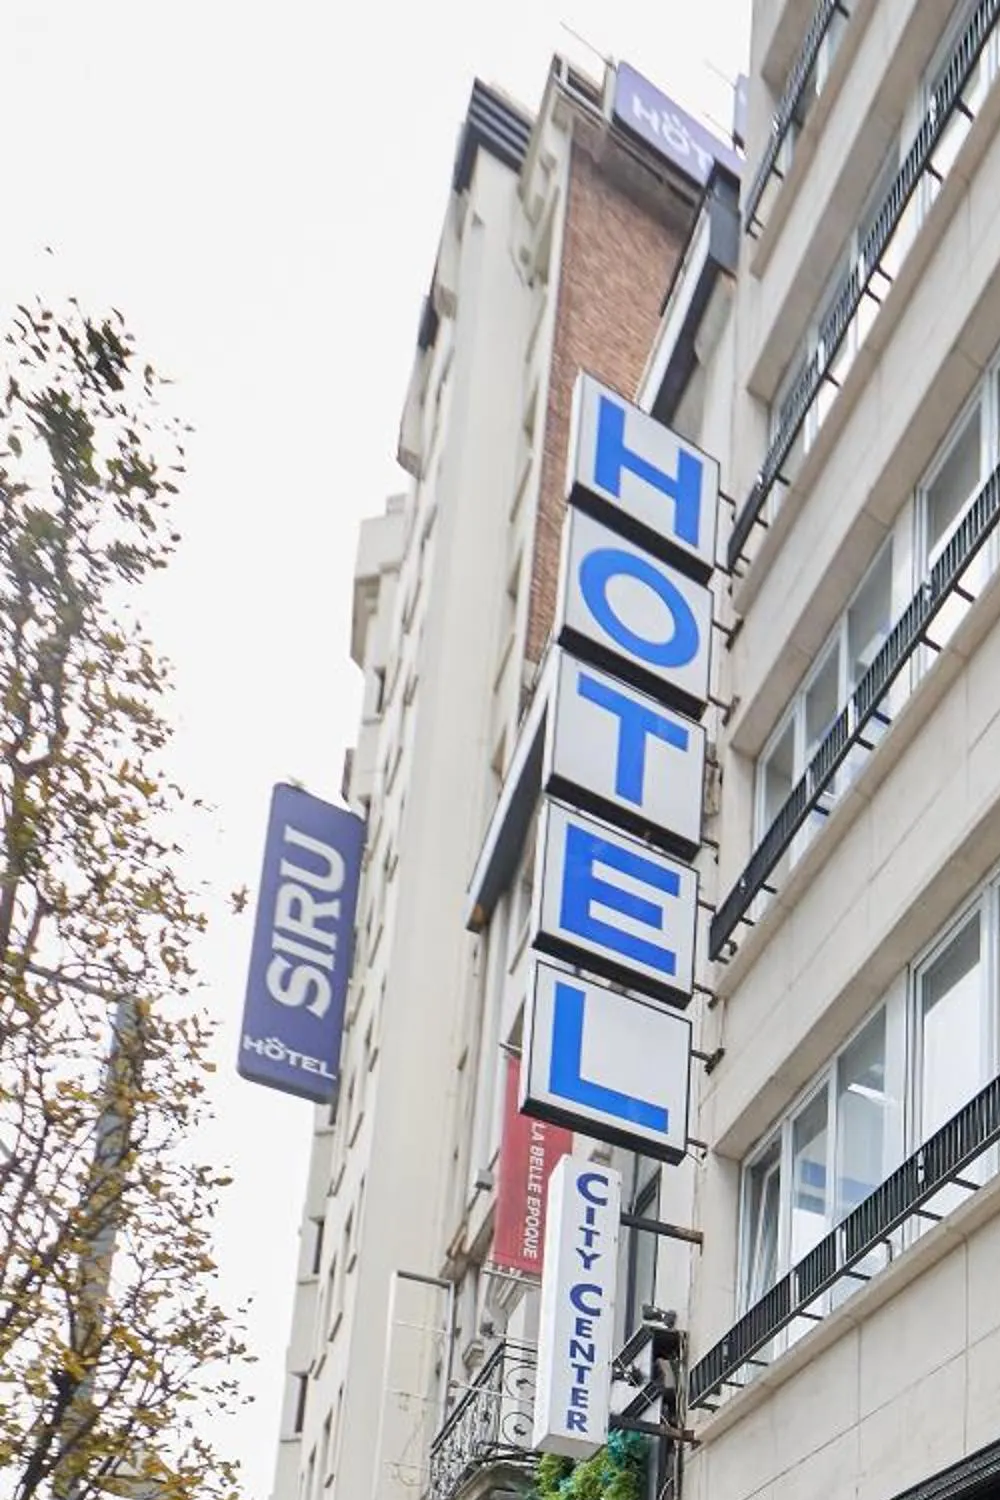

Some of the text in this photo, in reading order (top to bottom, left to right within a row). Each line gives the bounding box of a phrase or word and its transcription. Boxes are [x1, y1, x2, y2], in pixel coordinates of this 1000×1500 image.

[548, 395, 703, 1133] HOTEL
[265, 824, 347, 1019] SIRU
[523, 1121, 546, 1259] LA BELLE EPOQUE
[566, 1172, 609, 1433] CITY CENTER
